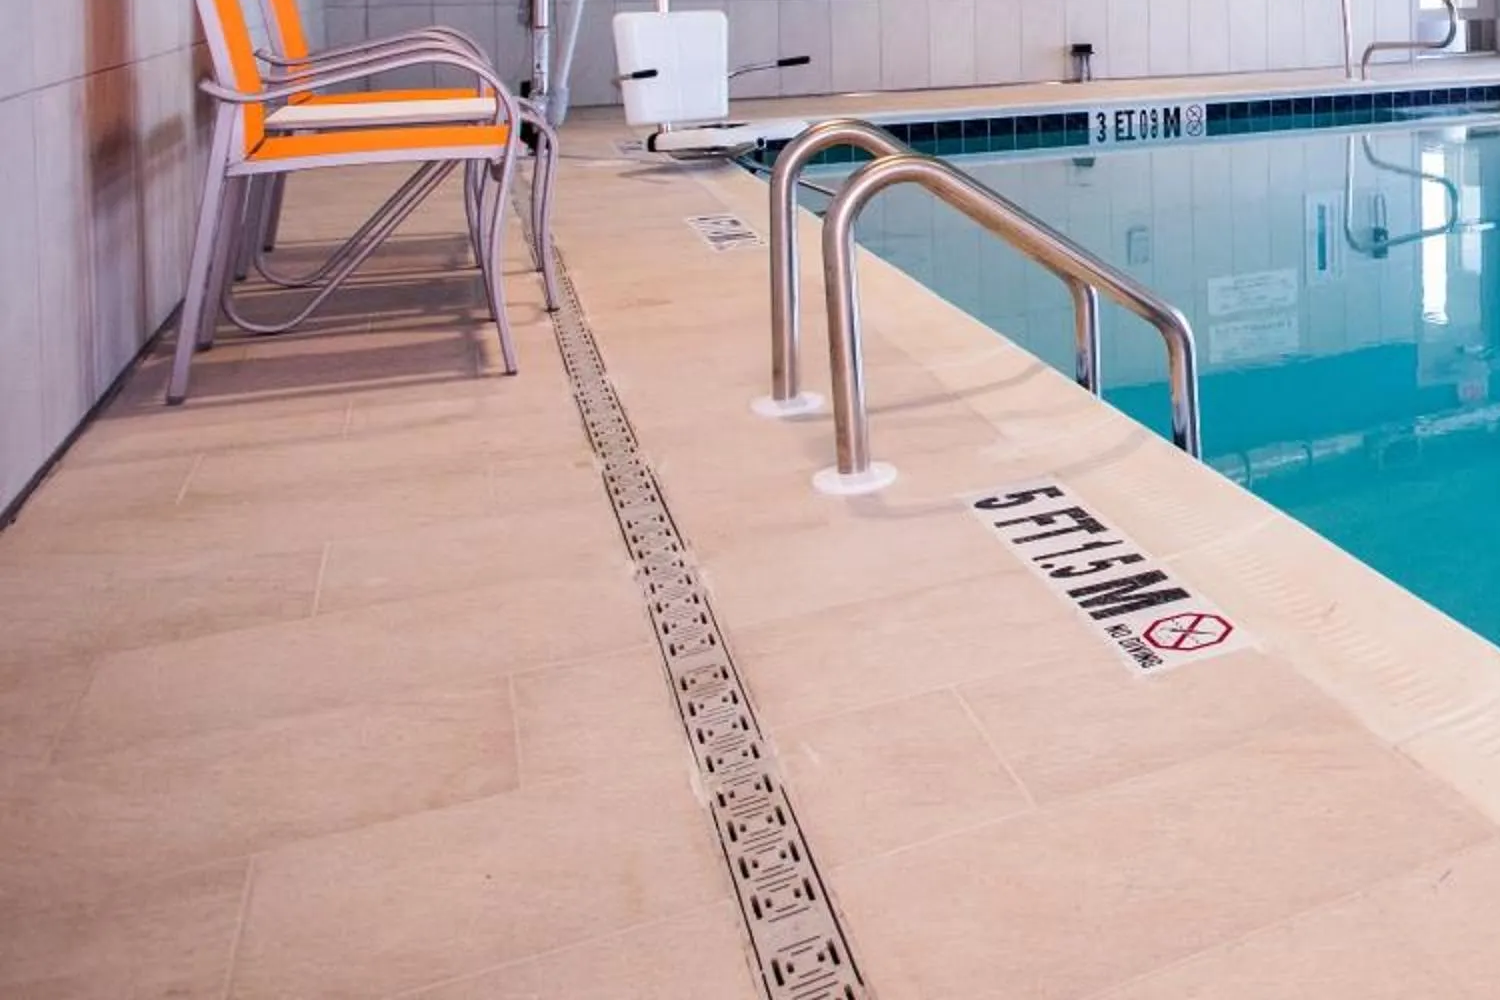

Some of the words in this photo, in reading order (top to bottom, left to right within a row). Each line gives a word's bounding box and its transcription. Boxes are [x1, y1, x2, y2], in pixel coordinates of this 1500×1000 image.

[973, 485, 1065, 510] 5
[994, 506, 1108, 544] FT
[1032, 539, 1146, 578] 1.5
[1066, 569, 1192, 620] M
[1104, 623, 1132, 638] NO
